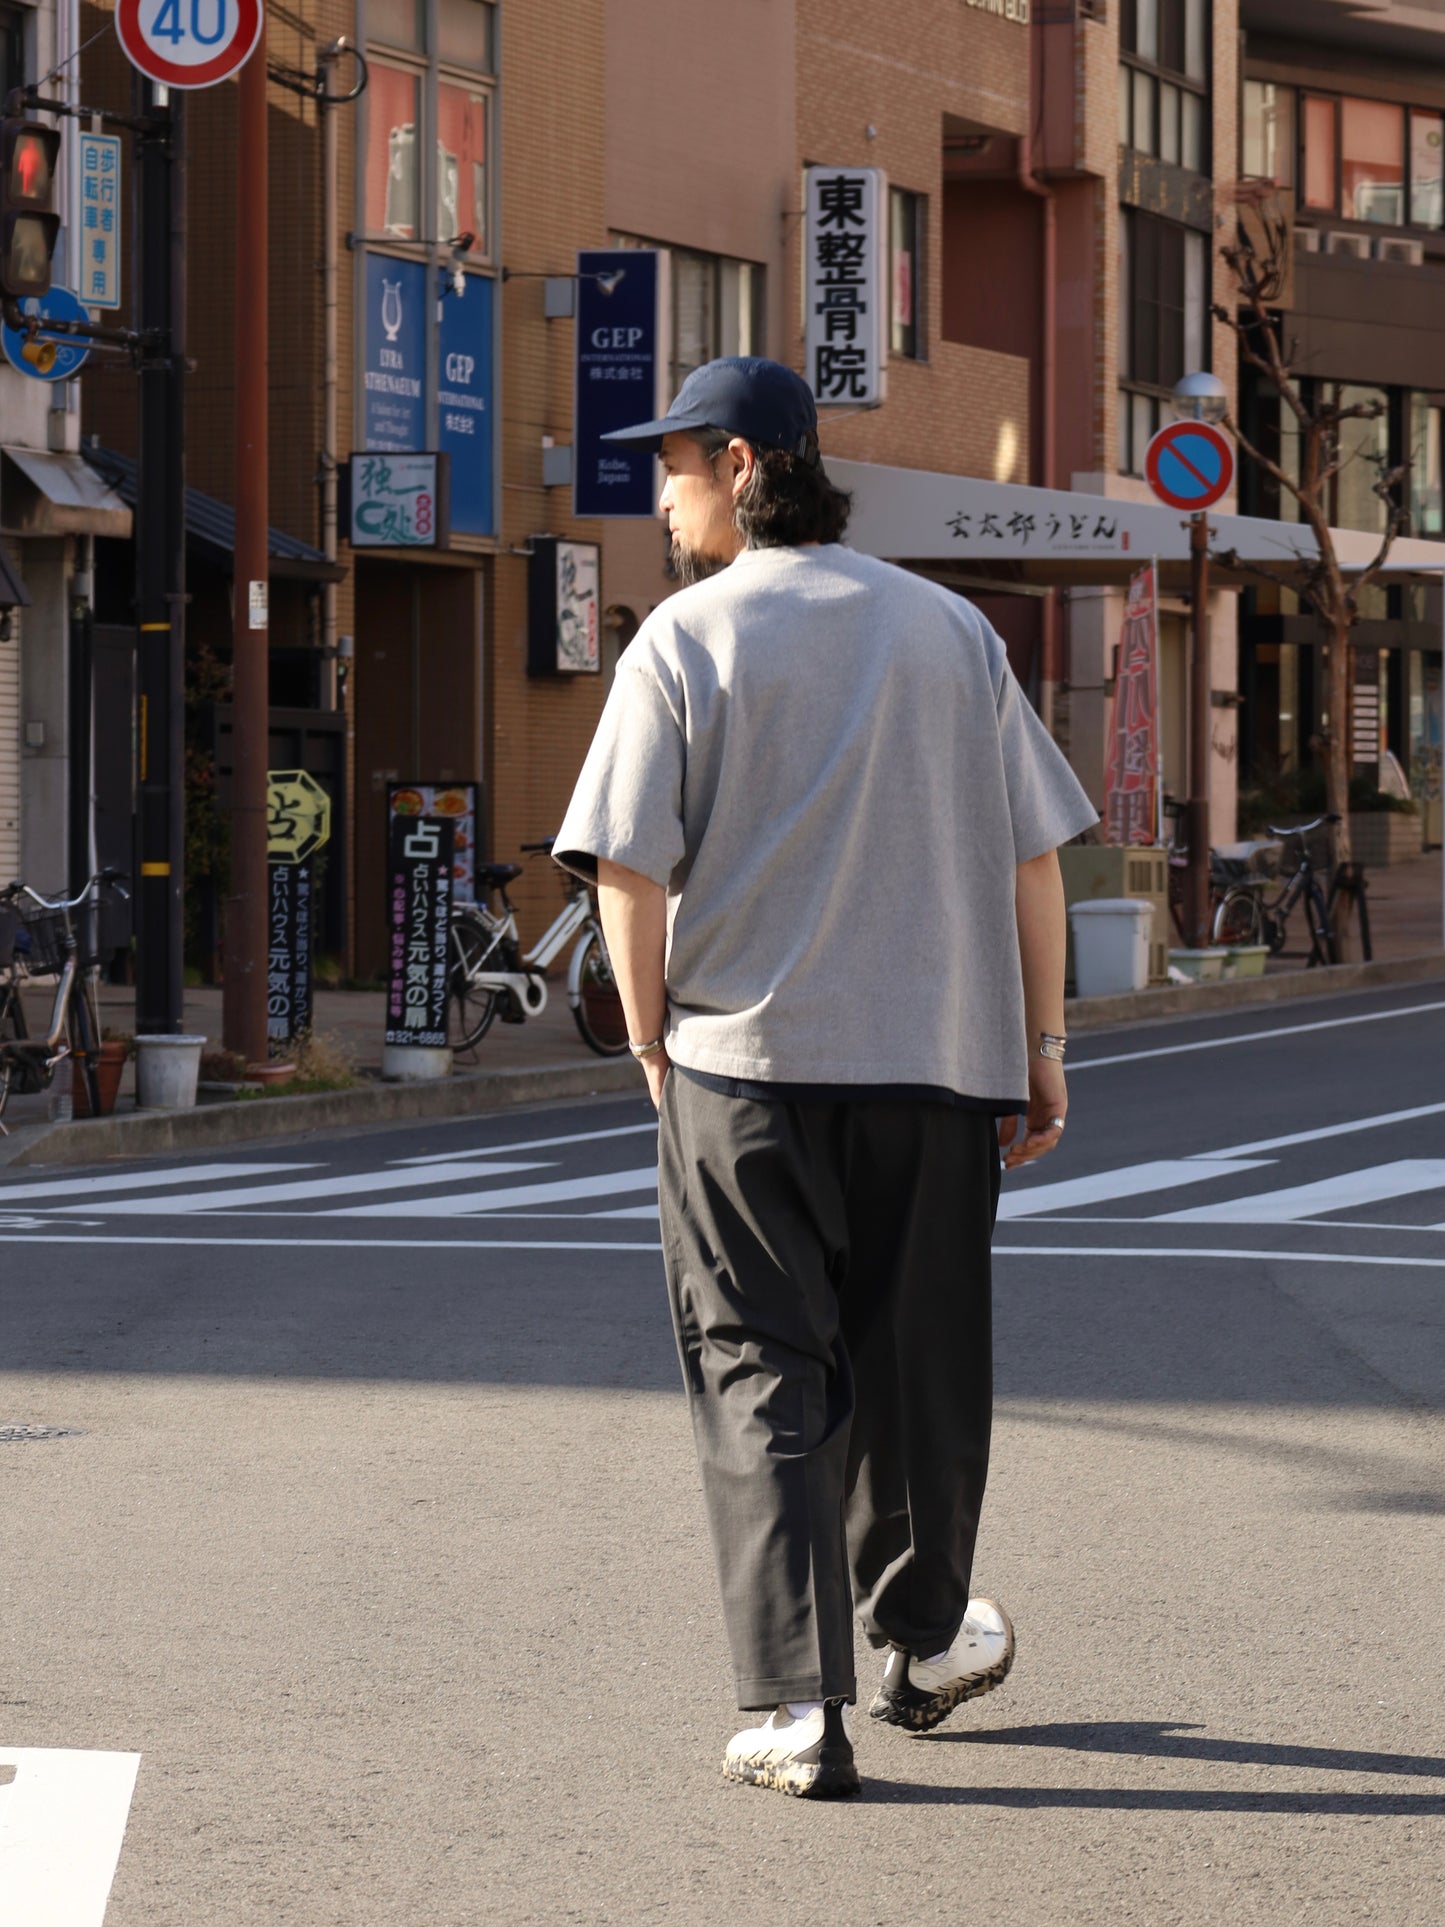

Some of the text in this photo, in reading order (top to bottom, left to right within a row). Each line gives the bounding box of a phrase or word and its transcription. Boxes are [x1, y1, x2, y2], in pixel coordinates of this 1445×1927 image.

[151, 0, 226, 45] 40
[84, 146, 99, 229] 自転車
[101, 147, 115, 232] 歩行者
[92, 238, 106, 295] 専用
[815, 175, 867, 399] 東整骨院
[591, 327, 644, 349] GEP
[446, 352, 475, 385] GEP
[590, 367, 643, 381] 株式会社
[404, 819, 441, 859] 占
